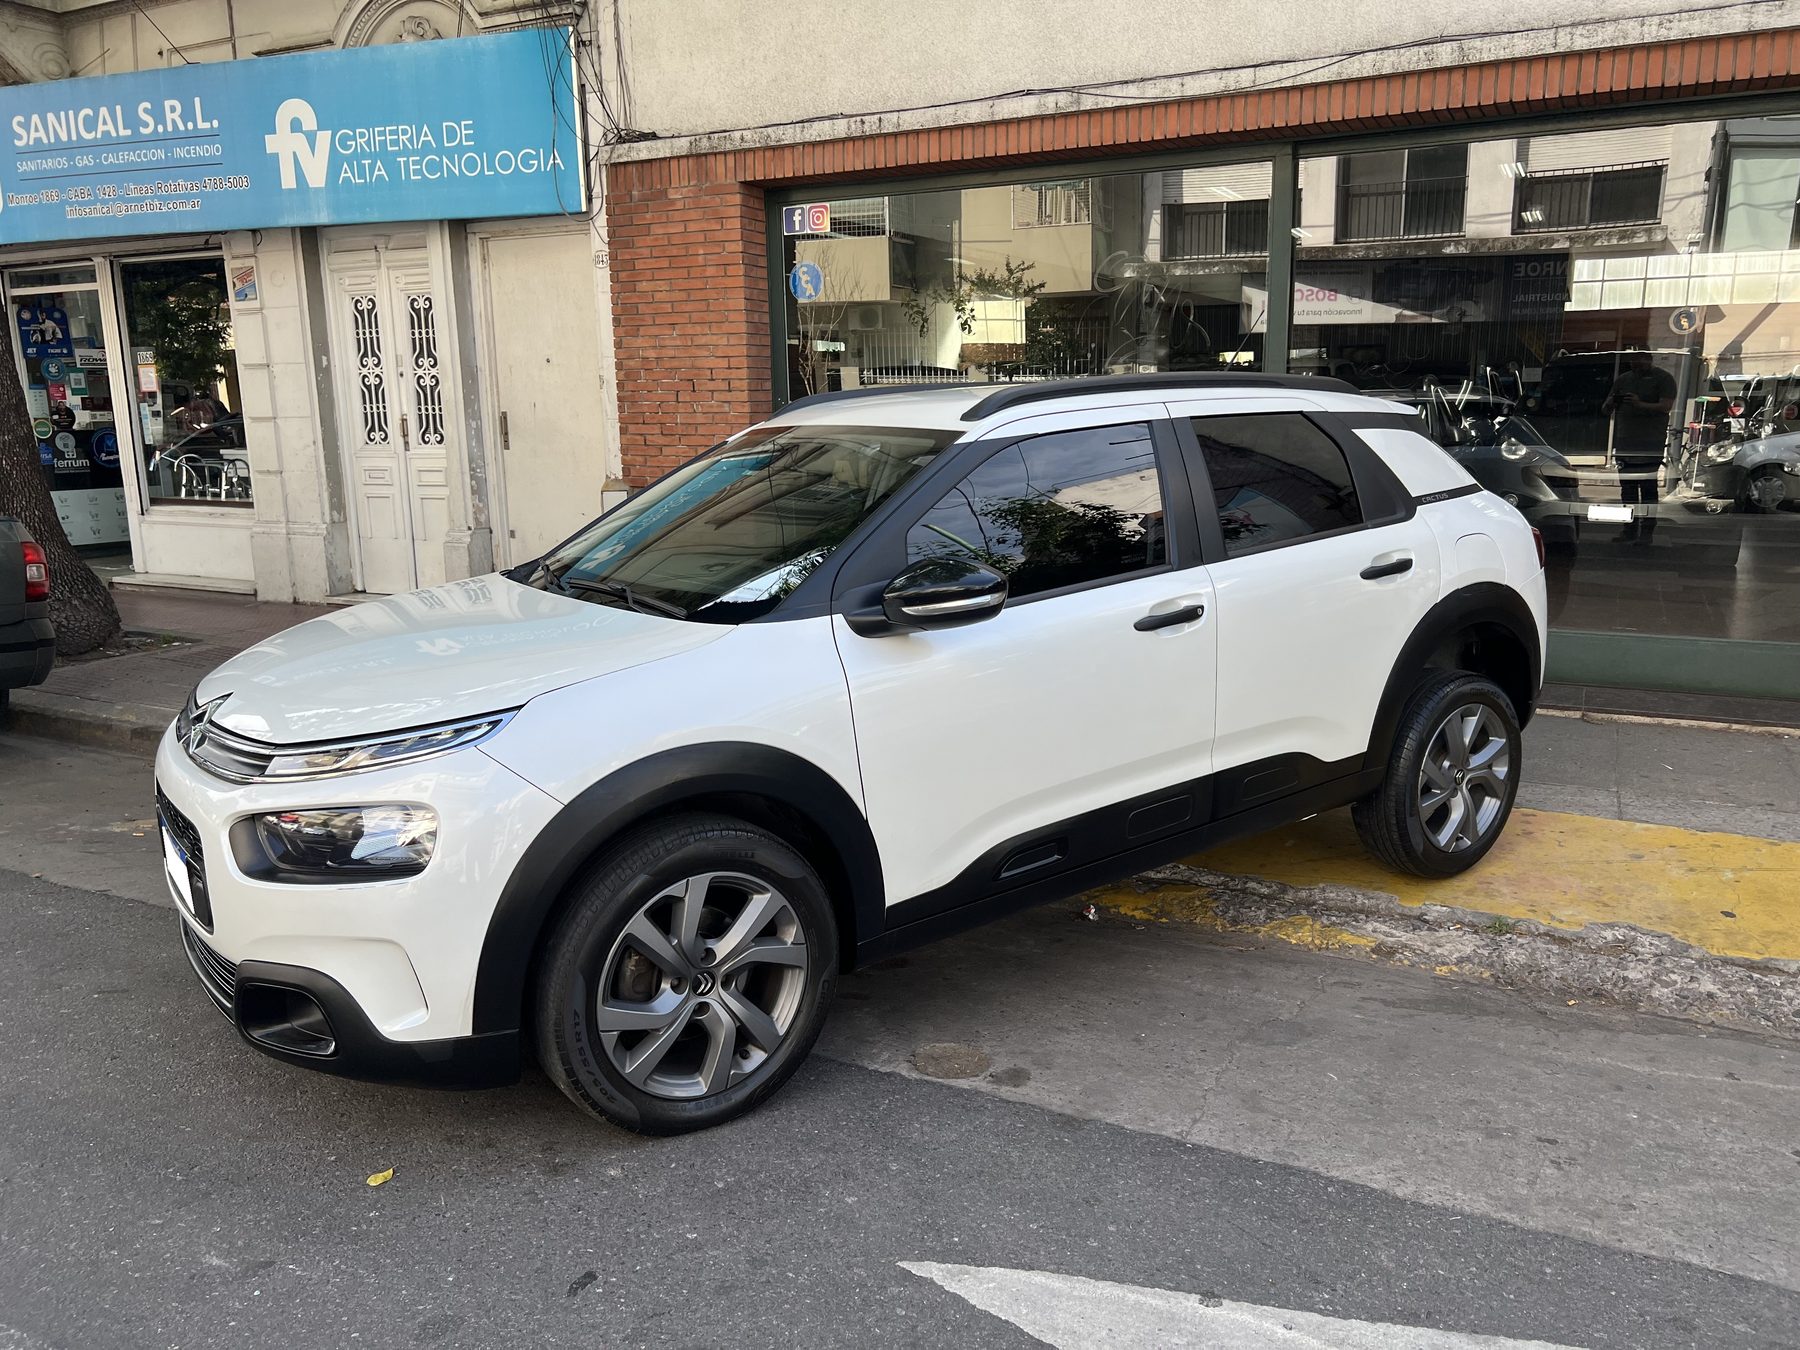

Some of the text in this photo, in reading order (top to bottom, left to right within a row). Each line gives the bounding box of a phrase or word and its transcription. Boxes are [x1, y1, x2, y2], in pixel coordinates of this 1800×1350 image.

[12, 97, 220, 147] SANICAL S.R.L.
[335, 120, 475, 154] GRIFERIA DE
[16, 157, 69, 173] SANITARIOS
[75, 154, 95, 168] GAS
[101, 147, 165, 165] CALEFACCION
[173, 143, 222, 159] INCENDIO
[338, 148, 565, 185] ALTA TECNOLOGIA
[7, 190, 39, 207] Monroe
[40, 186, 60, 203] 1869
[66, 185, 94, 202] CABA
[96, 184, 118, 200] 1428
[156, 178, 201, 196] Rotativas
[201, 175, 250, 192] 4788-5003
[138, 352, 154, 364] 1869
[53, 457, 90, 468] ferrum
[1421, 492, 1449, 503] CACTUS
